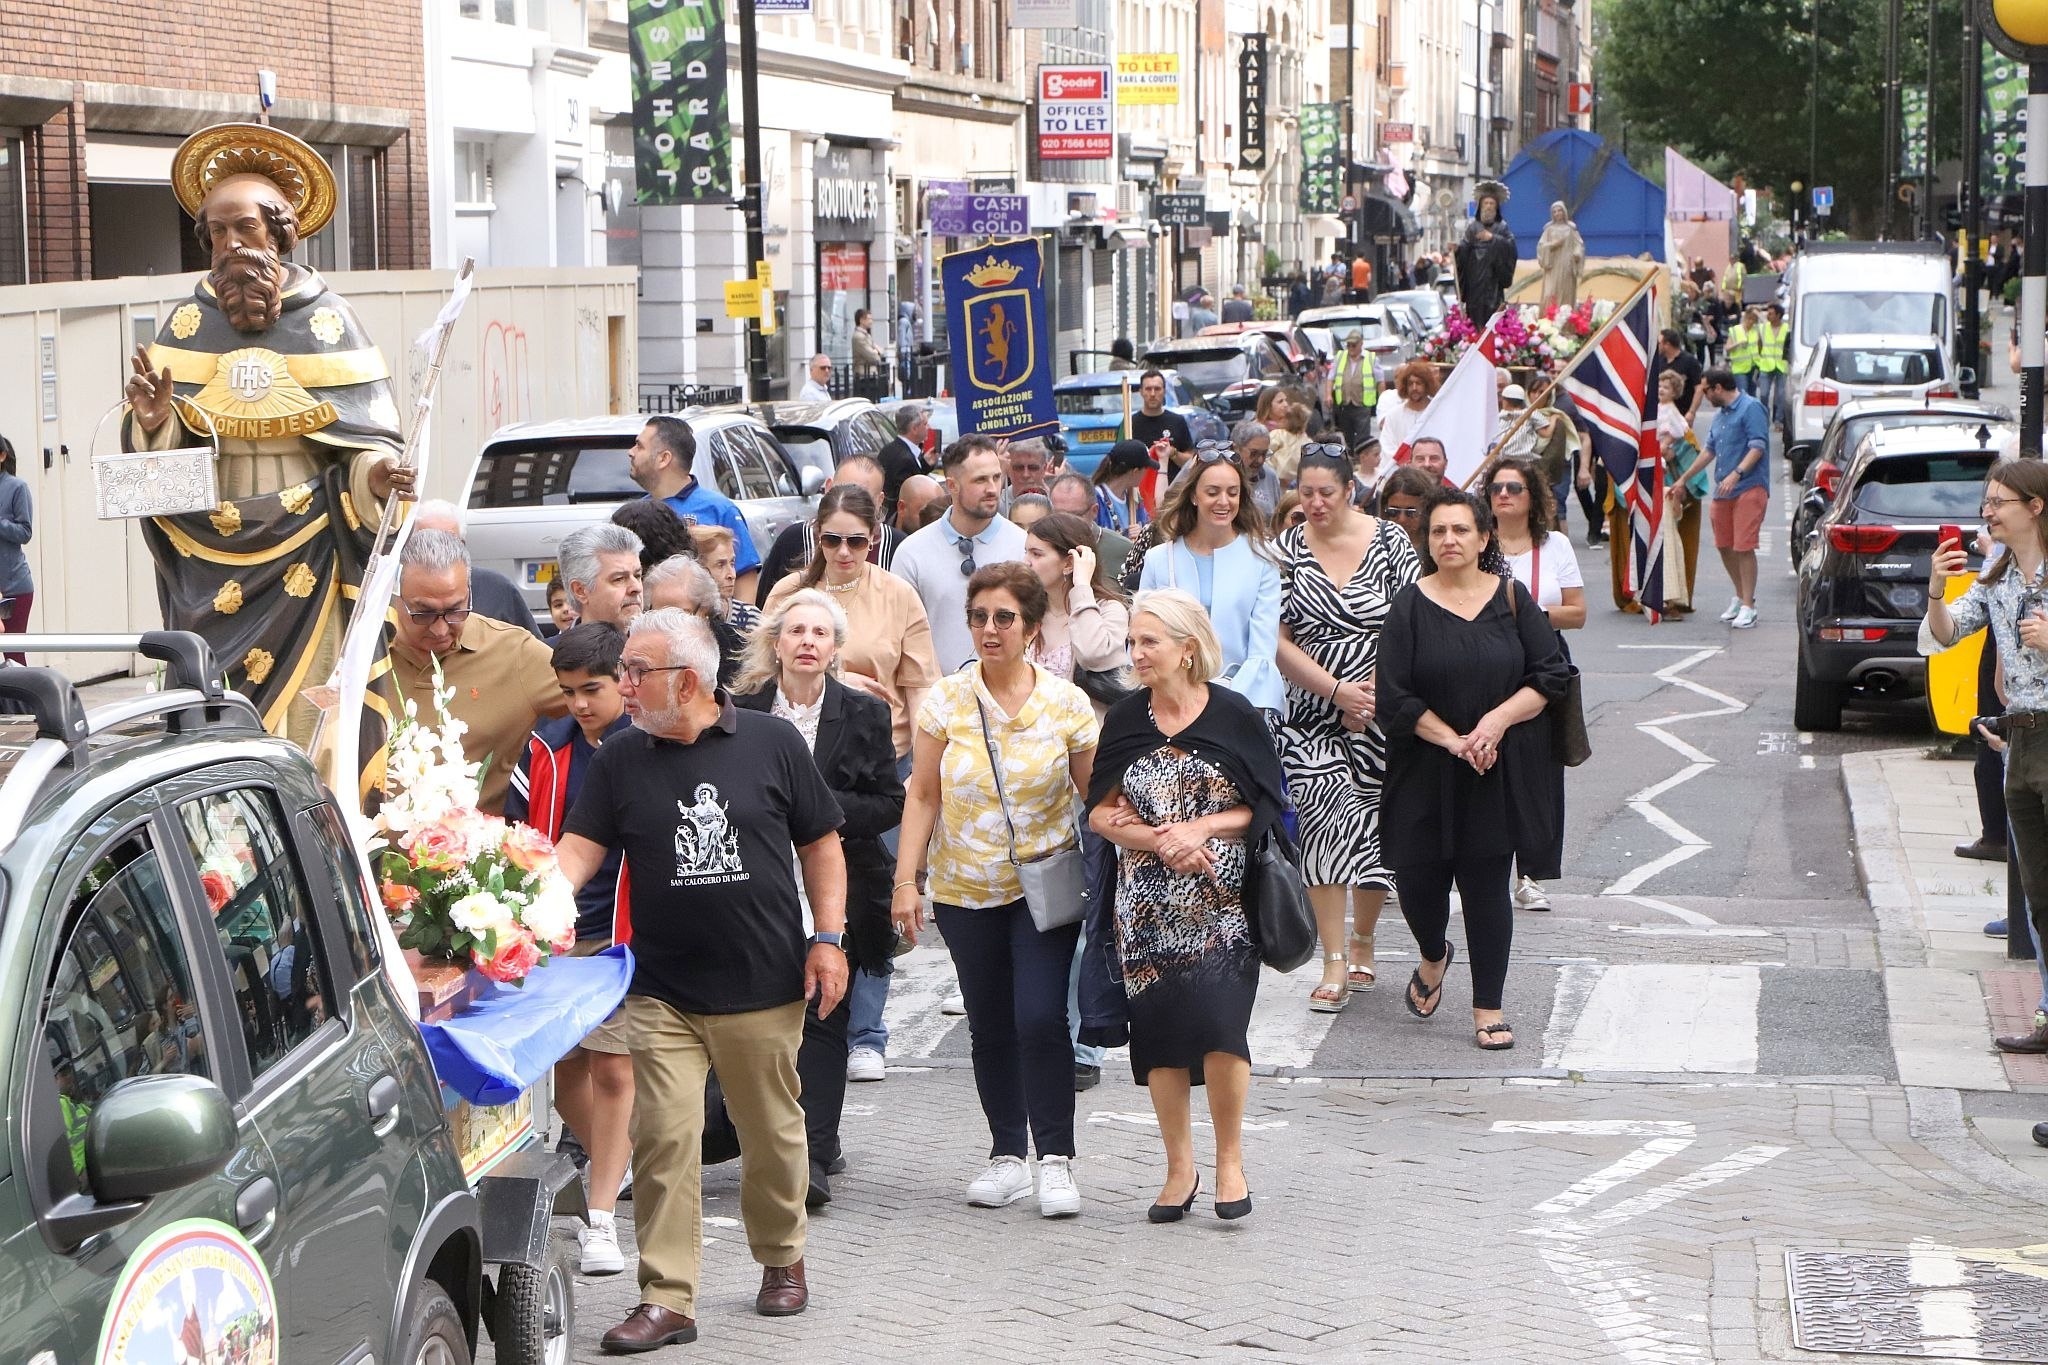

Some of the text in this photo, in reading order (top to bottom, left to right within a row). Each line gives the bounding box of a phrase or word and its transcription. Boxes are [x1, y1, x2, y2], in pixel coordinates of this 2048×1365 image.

[1118, 61, 1173, 72] TO LET
[1246, 38, 1259, 145] RAPHAEL
[1047, 106, 1105, 116] OFFICES
[1044, 119, 1107, 131] TO LET
[1041, 138, 1060, 149] 020
[973, 197, 1022, 211] CASH
[1161, 197, 1200, 207] CASH
[987, 211, 1008, 220] FOR
[1161, 213, 1200, 223] GOLD
[972, 220, 1023, 234] GOLD
[231, 366, 273, 390] IHS
[972, 390, 1033, 410] ASSOCIAZIONE
[983, 404, 1024, 419] LUCCHESI
[205, 413, 273, 438] NOMINE
[277, 404, 331, 436] JESU
[976, 413, 1033, 432] LONDRA 1973
[1890, 588, 1920, 606] GB
[670, 872, 750, 887] SAN CALOGERO DI NARO
